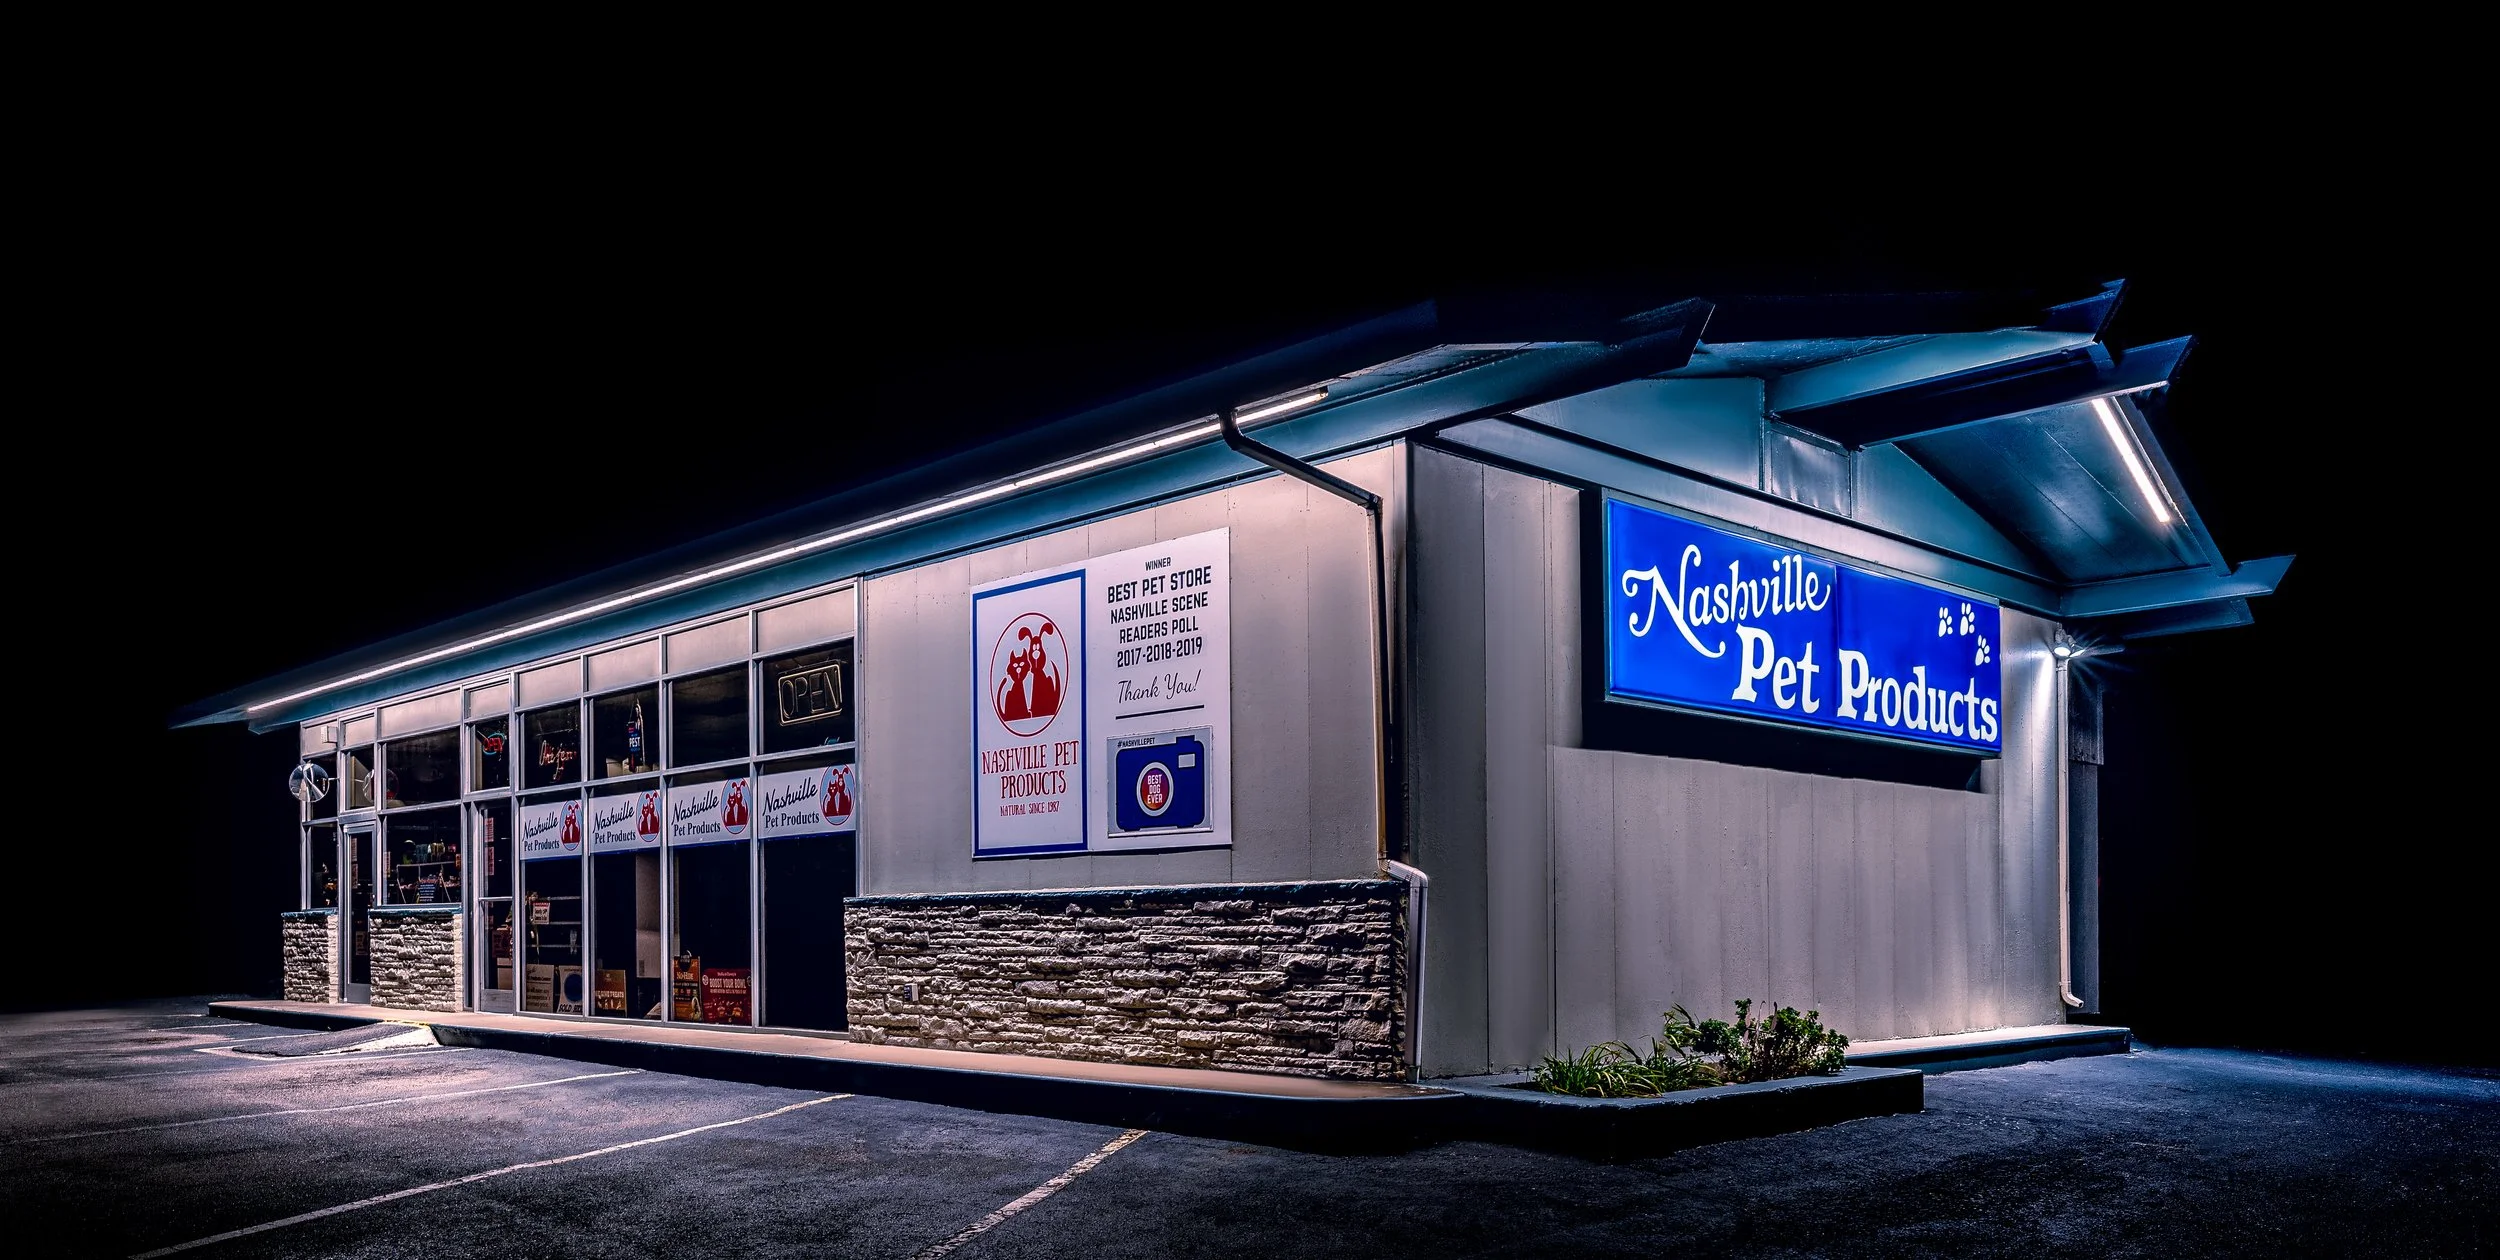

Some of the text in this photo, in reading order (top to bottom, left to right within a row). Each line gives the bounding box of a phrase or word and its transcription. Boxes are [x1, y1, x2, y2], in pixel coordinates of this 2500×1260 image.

[1145, 556, 1171, 571] WINNER
[1107, 565, 1212, 604] BEST PET STORE
[1110, 591, 1208, 625] NASHVILLE SCENE
[1622, 544, 1831, 658] Nashville
[1119, 616, 1199, 644] READERS POLL
[782, 670, 840, 719] OPEN
[1117, 669, 1202, 704] Thank You!
[1731, 624, 1998, 743] Pet Products
[1117, 737, 1156, 748] #NASHVILLEPET
[982, 740, 1080, 774] NASHVILLE PET
[1001, 770, 1067, 799] PRODUCTS
[1147, 774, 1162, 785] BEST
[1149, 784, 1161, 794] DOG
[671, 789, 719, 825] Nashville
[762, 777, 818, 816] Nashville
[1000, 803, 1026, 817] NATURAL
[1029, 801, 1045, 815] SINCE
[1147, 793, 1163, 804] EVER
[522, 811, 559, 842] Nashville
[592, 800, 635, 834] Nashville
[674, 821, 721, 837] Pet Products
[765, 810, 820, 829] Pet Products
[524, 839, 560, 851] Pet Products
[595, 829, 636, 844] Pet Products
[559, 1004, 572, 1013] SOLD
